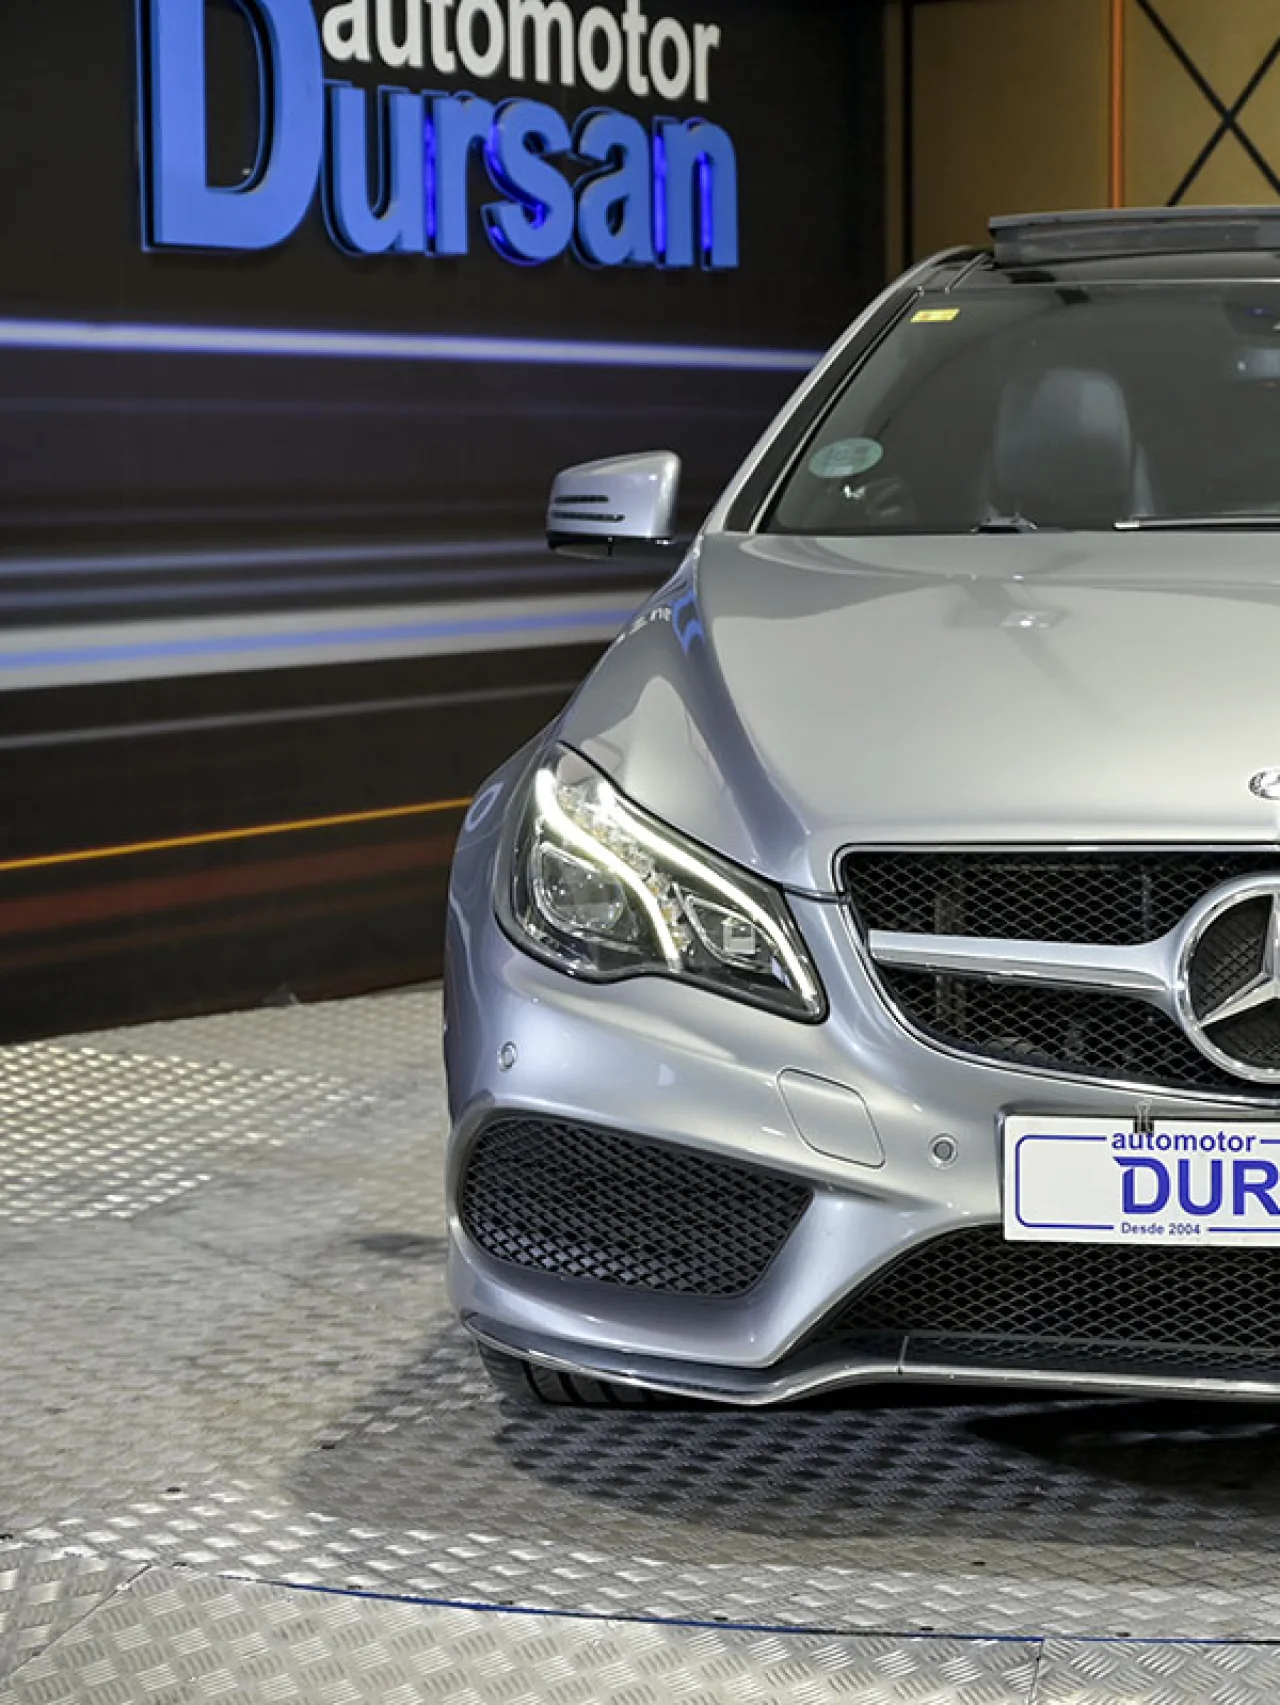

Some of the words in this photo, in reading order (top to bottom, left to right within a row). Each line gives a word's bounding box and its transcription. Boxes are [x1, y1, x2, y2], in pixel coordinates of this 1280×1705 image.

[321, 0, 720, 101] automotor
[136, 0, 739, 270] Dursan
[1111, 1131, 1257, 1152] automotor
[1121, 1221, 1166, 1235] Desde
[1168, 1222, 1202, 1236] 2004
